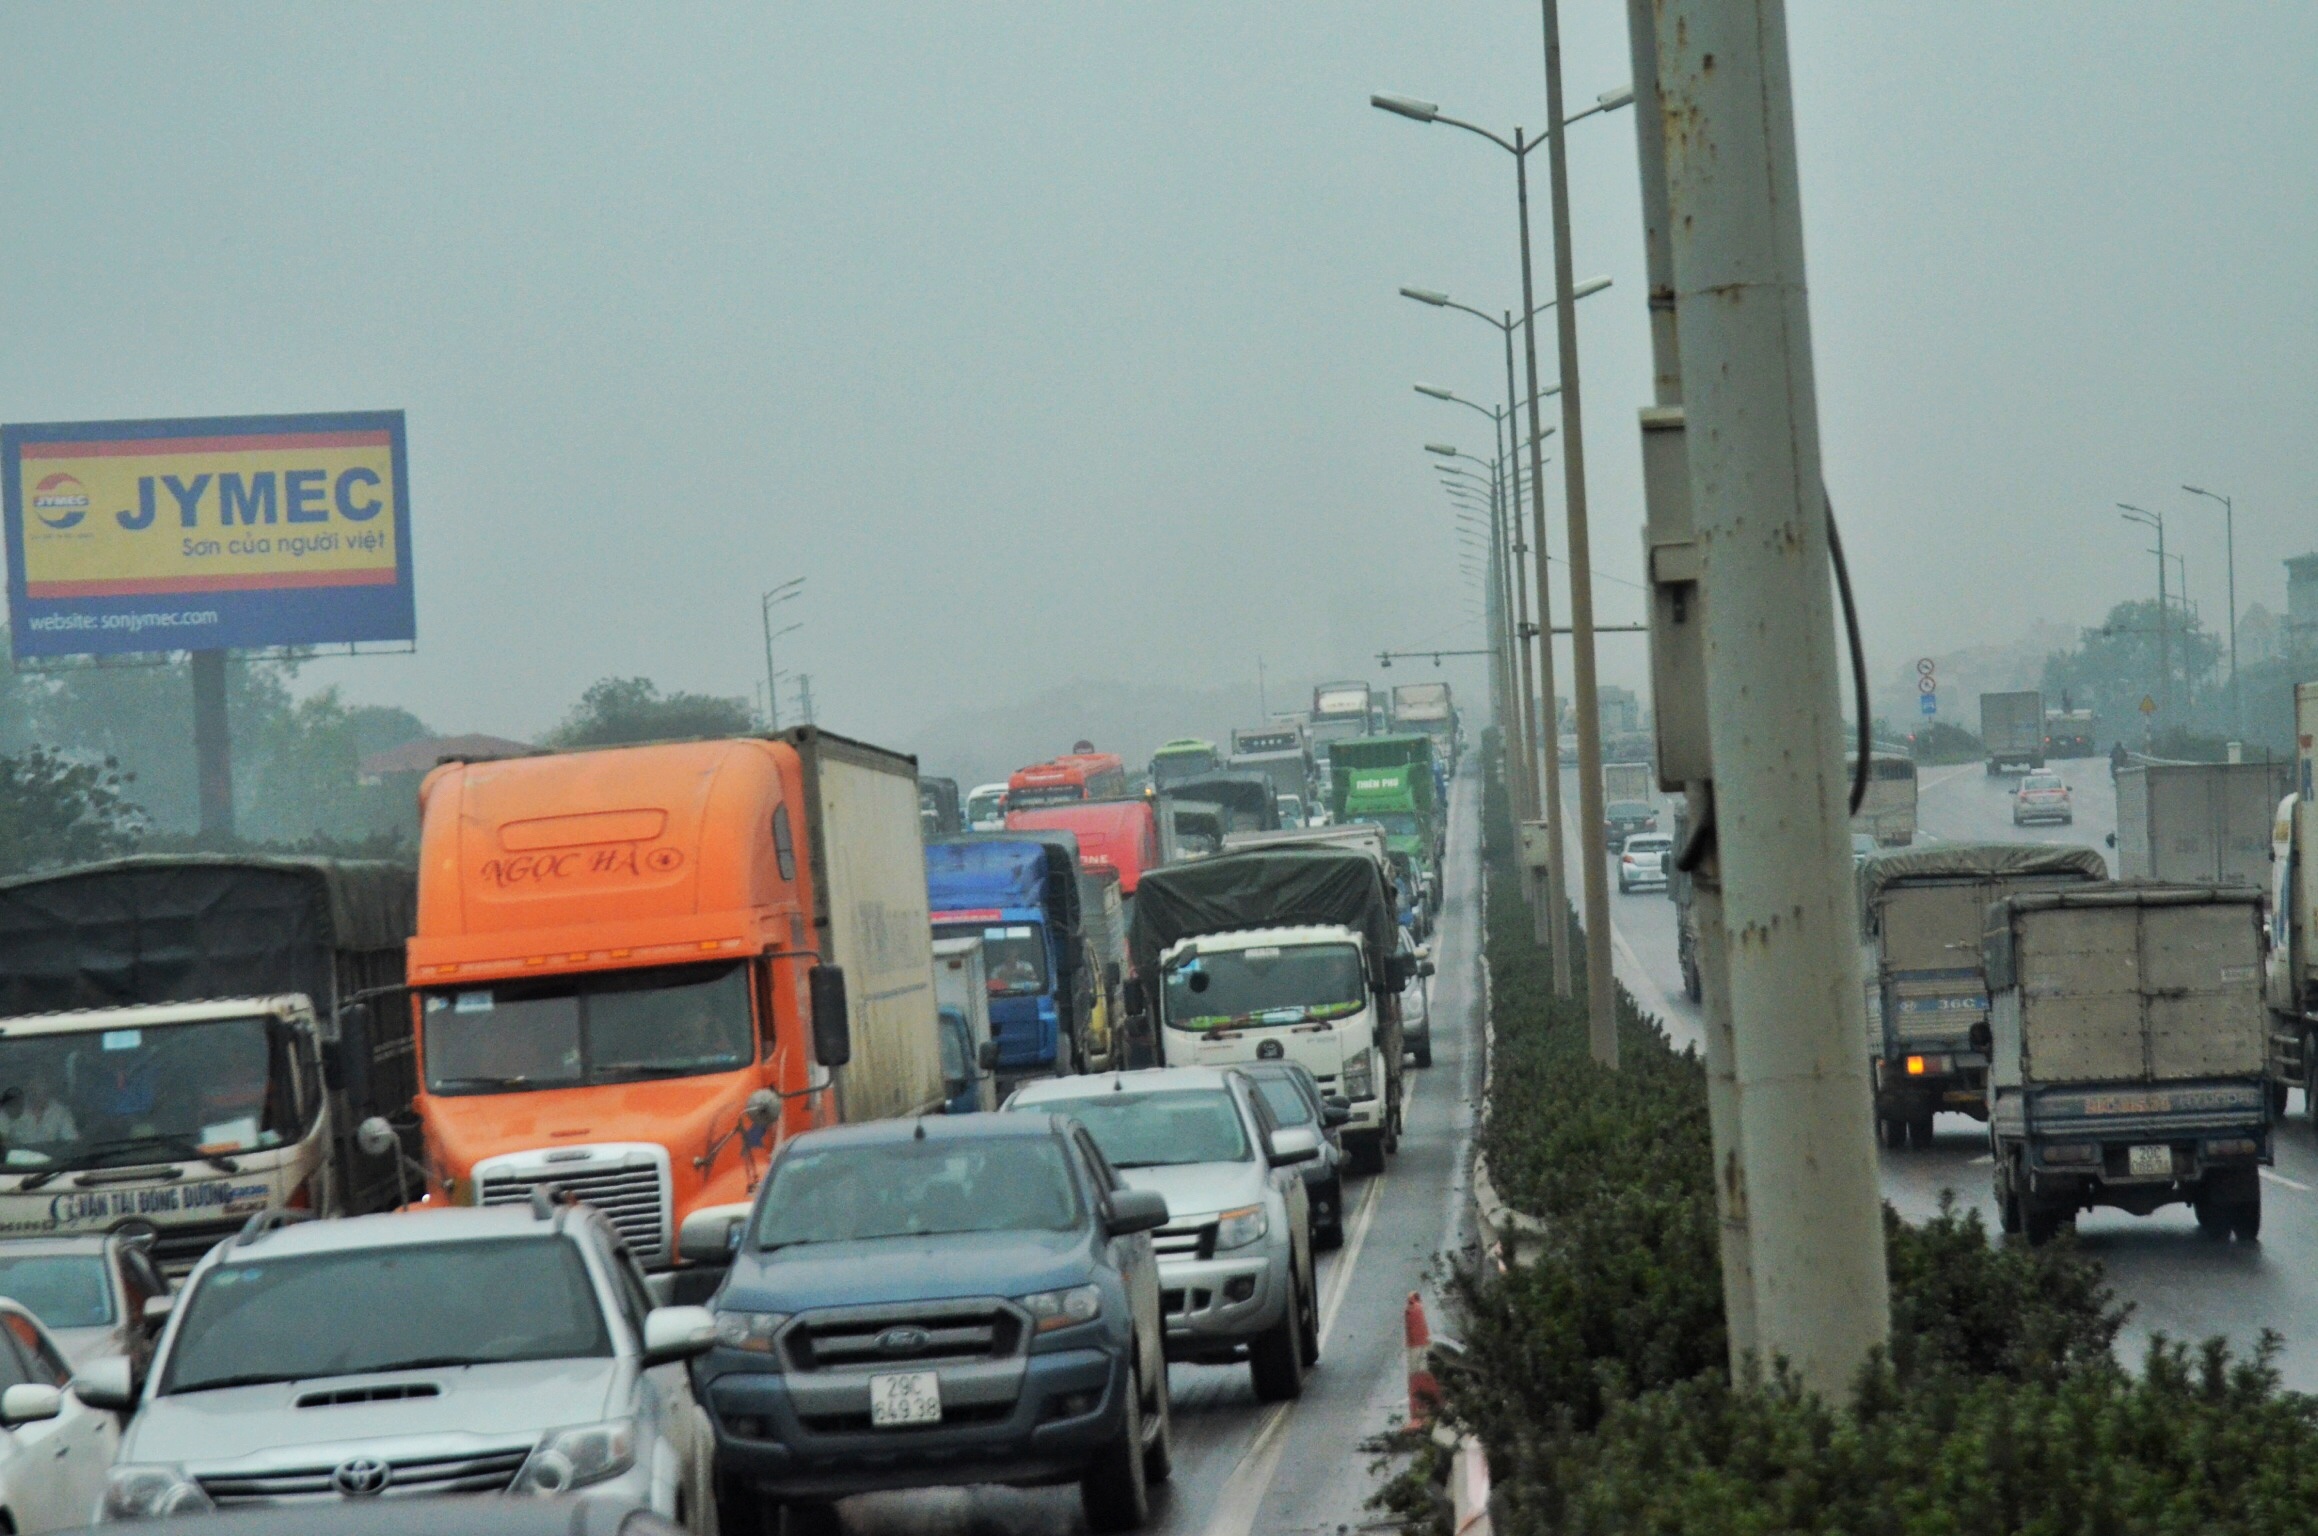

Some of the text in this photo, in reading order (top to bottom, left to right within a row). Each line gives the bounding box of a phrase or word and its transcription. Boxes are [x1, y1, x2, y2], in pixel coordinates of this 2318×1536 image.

[115, 467, 383, 530] JYMEC
[182, 537, 221, 556] Sơn
[229, 533, 270, 554] của
[278, 533, 339, 557] người
[28, 610, 218, 633] website: sonjymec.com
